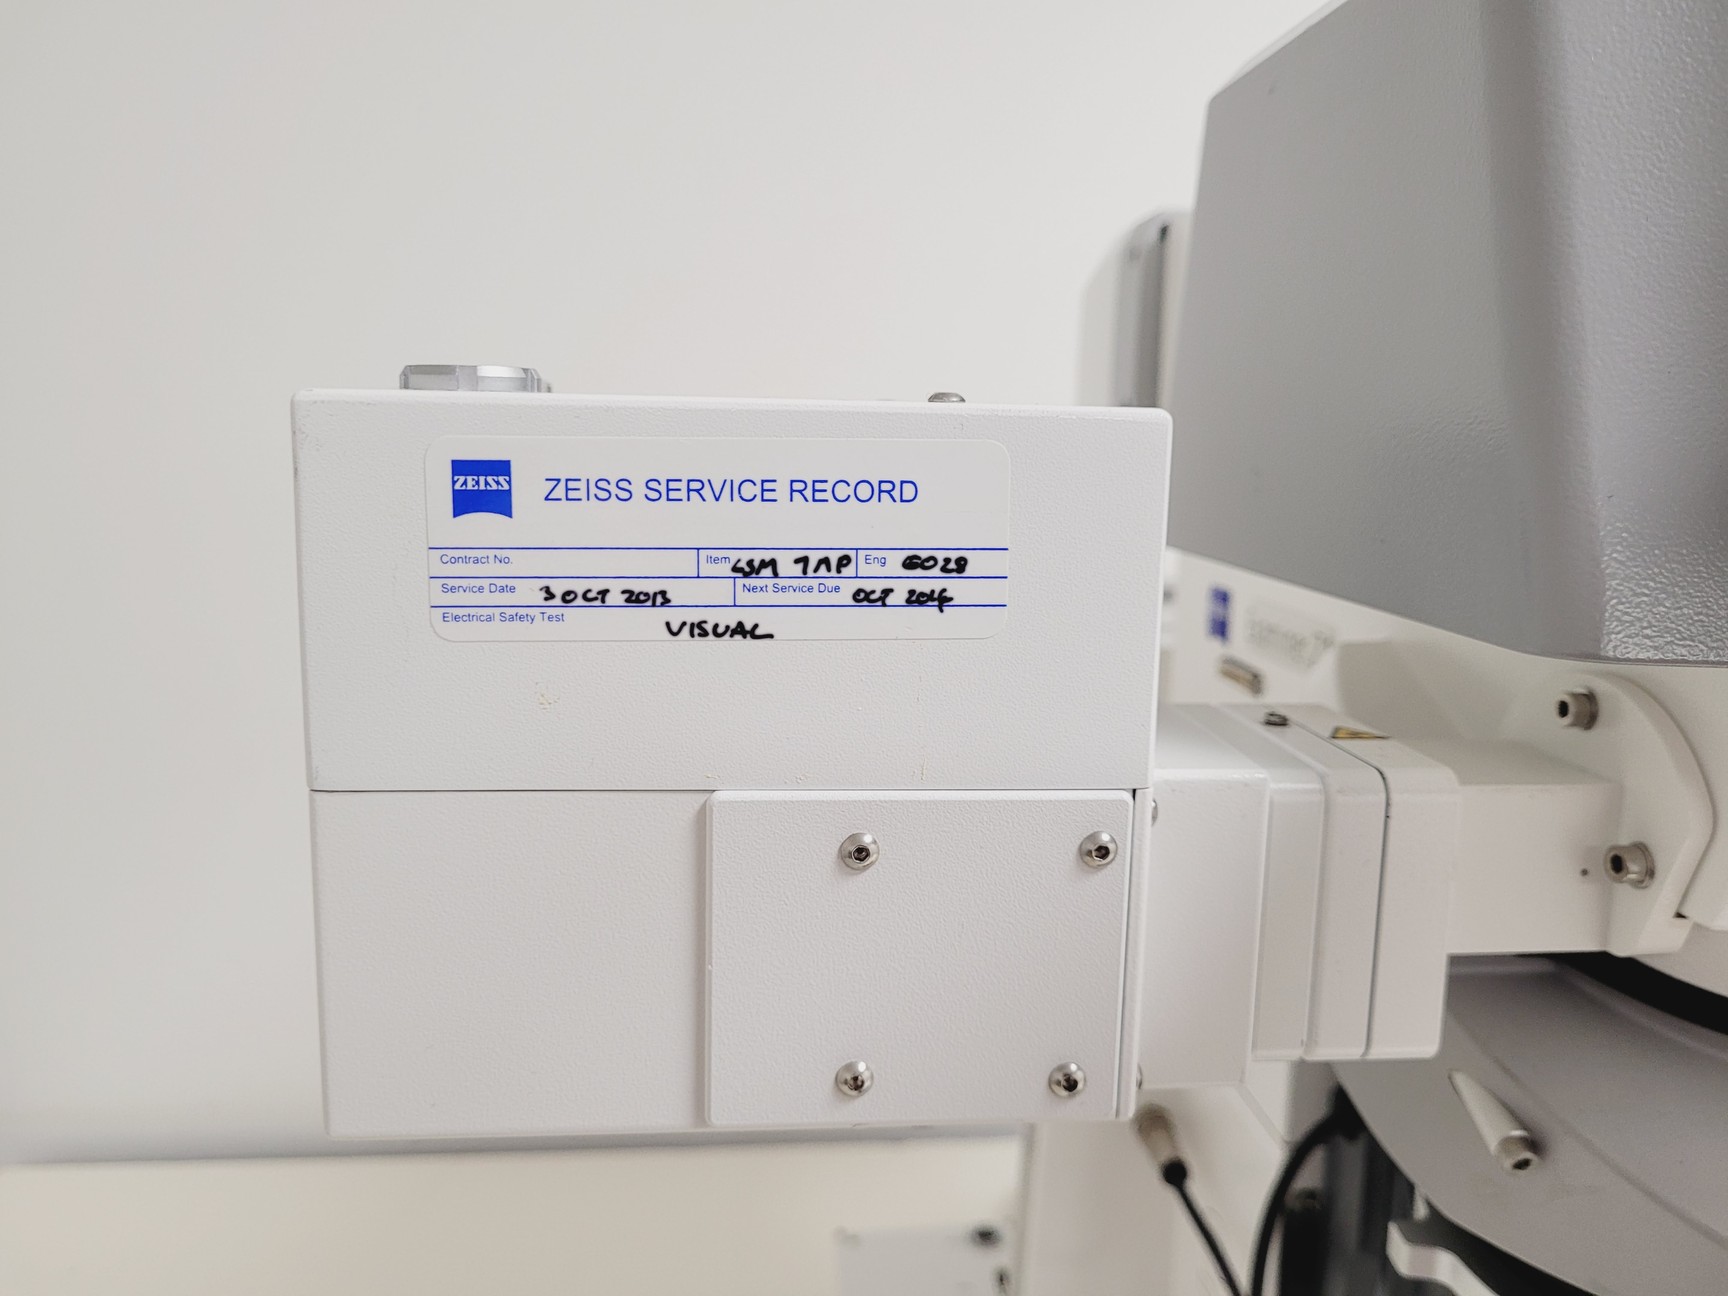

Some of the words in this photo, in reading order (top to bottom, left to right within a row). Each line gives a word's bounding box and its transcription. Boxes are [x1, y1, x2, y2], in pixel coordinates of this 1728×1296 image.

[454, 475, 510, 491] ZEISS
[543, 477, 634, 503] ZEISS
[644, 477, 778, 503] SERVICE
[789, 478, 919, 504] RECORD
[440, 554, 490, 565] Contract
[493, 554, 513, 565] No.
[705, 554, 731, 565] Item
[864, 554, 887, 567] Eng
[441, 583, 485, 594] Service
[488, 583, 517, 594] Date
[742, 583, 769, 593] Next
[771, 583, 815, 593] Service
[817, 583, 841, 593] Due
[560, 588, 611, 605] OCT
[620, 589, 672, 607] 2013
[852, 588, 895, 607] OCT
[441, 612, 495, 623] Electrical
[499, 612, 536, 624] Safety
[540, 612, 565, 623] Test
[665, 620, 774, 639] VISUAL
